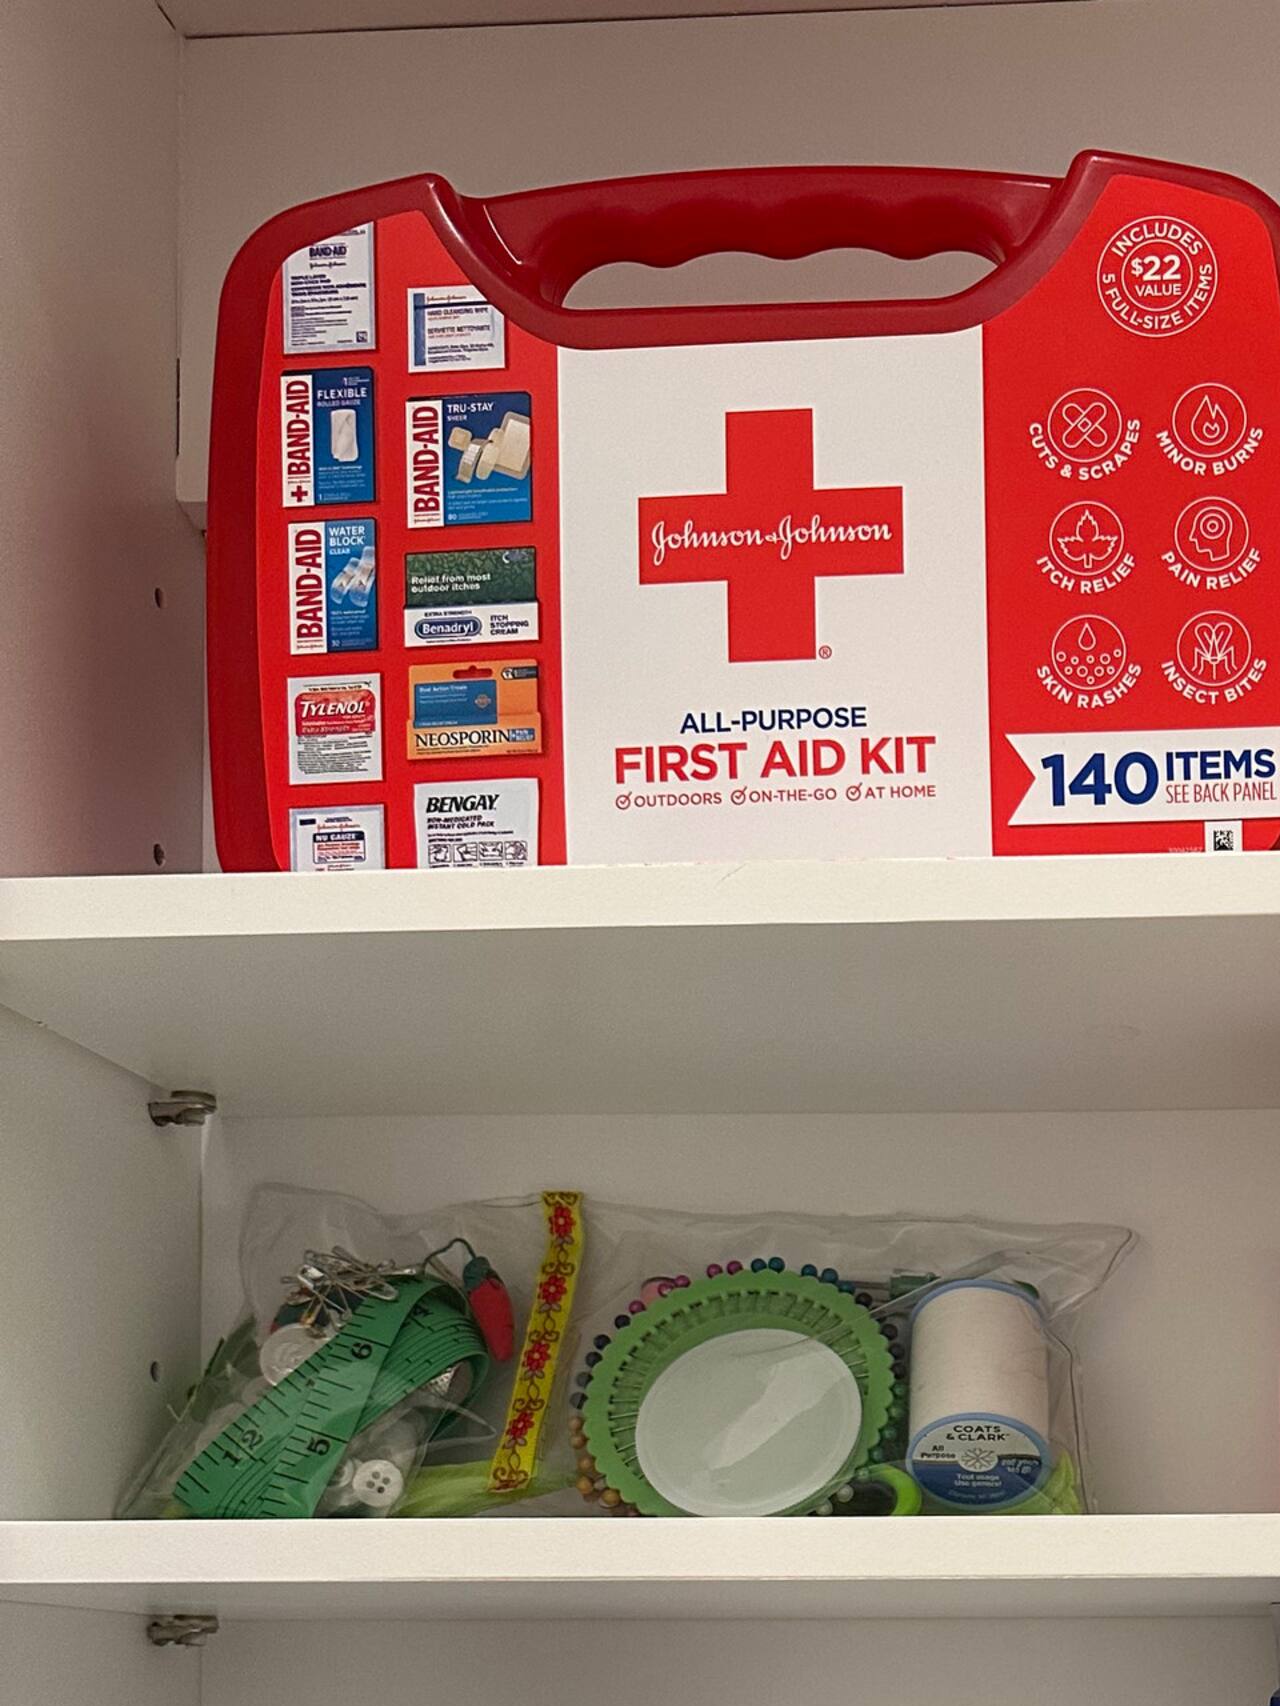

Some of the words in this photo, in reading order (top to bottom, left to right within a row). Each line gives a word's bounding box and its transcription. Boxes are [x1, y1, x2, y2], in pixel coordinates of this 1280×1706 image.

[1111, 221, 1204, 258] INCLUDES
[1102, 272, 1116, 284] 5
[1130, 254, 1182, 282] $22
[1134, 283, 1182, 297] VALUE
[1186, 263, 1213, 318] ITEMS
[1104, 285, 1185, 331] FULL-SIZE
[317, 387, 368, 400] FLEXIBLE
[446, 402, 494, 414] TRU-STAY
[1028, 422, 1060, 470] CUTS
[1060, 463, 1073, 479] &
[1078, 418, 1141, 481] SCRAPES
[1155, 429, 1206, 476] MINOR
[1212, 427, 1265, 476] BURNS
[328, 526, 365, 537] WATER
[329, 536, 364, 547] BLOCK
[1036, 556, 1076, 593] ITCH
[1080, 552, 1138, 594] RELIEF
[1161, 550, 1201, 590] PAIN
[1206, 547, 1262, 590] RELIEF
[422, 622, 474, 637] Benadryl
[1036, 665, 1073, 706] SKIN
[1076, 662, 1143, 709] RASHES
[1161, 660, 1219, 706] INSECT
[1225, 657, 1268, 705] BITES
[679, 706, 868, 734] ALL-PURPOSE
[415, 729, 510, 747] NEOSPORIN
[614, 741, 748, 784] FIRST
[760, 738, 846, 778] AID
[860, 735, 937, 775] KIT
[1040, 751, 1160, 807] 140
[1166, 748, 1276, 781] ITEMS
[426, 794, 500, 813] BENGAY
[633, 791, 723, 808] OUTDOORS
[749, 787, 838, 803] ON-THE-GO
[865, 786, 886, 799] AT
[890, 784, 937, 799] HOME
[1165, 784, 1190, 805] SEE
[1193, 783, 1231, 803] BACK
[1233, 780, 1278, 802] PANEL
[350, 1341, 375, 1361] 6
[945, 1433, 955, 1441] &
[958, 1433, 1006, 1442] CLARK
[953, 1425, 1002, 1433] COATS
[306, 1437, 331, 1457] 5
